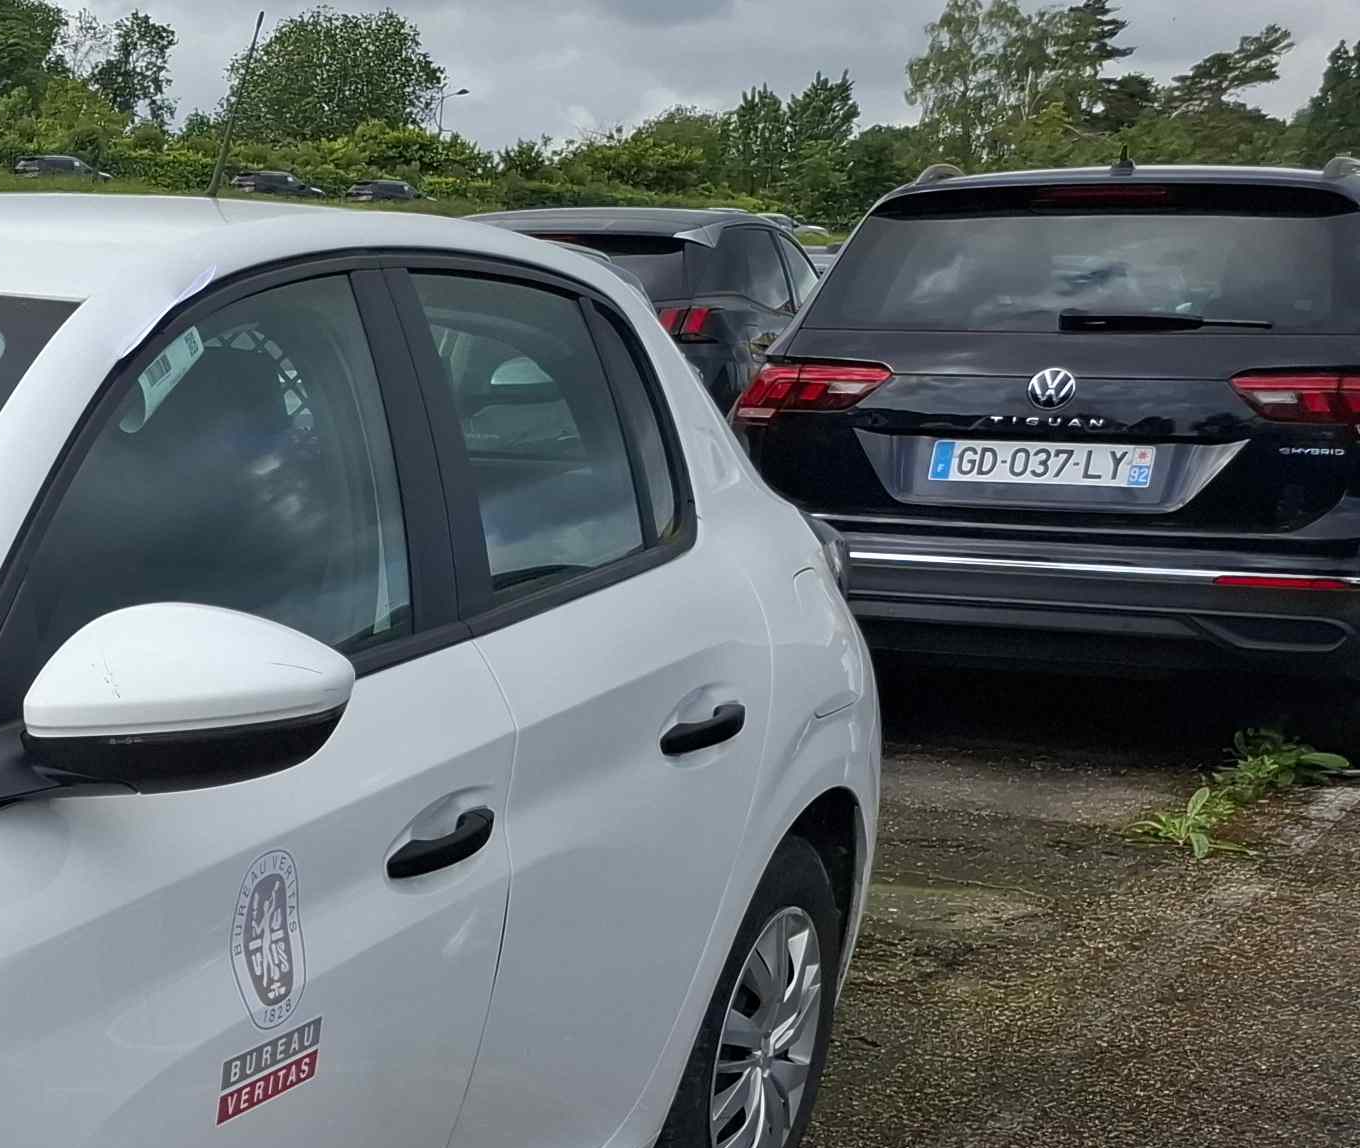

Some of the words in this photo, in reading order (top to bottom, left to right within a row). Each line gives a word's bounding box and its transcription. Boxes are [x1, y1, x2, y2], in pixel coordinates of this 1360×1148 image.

[989, 415, 1105, 428] TIGUAN
[956, 446, 1129, 481] GD-037-LY
[1129, 466, 1148, 483] 92
[233, 860, 267, 957] BUREAU
[272, 855, 298, 934] VERITAS
[262, 997, 292, 1024] 1828
[229, 1023, 315, 1082] BUREAU
[226, 1056, 310, 1117] VERITAS
